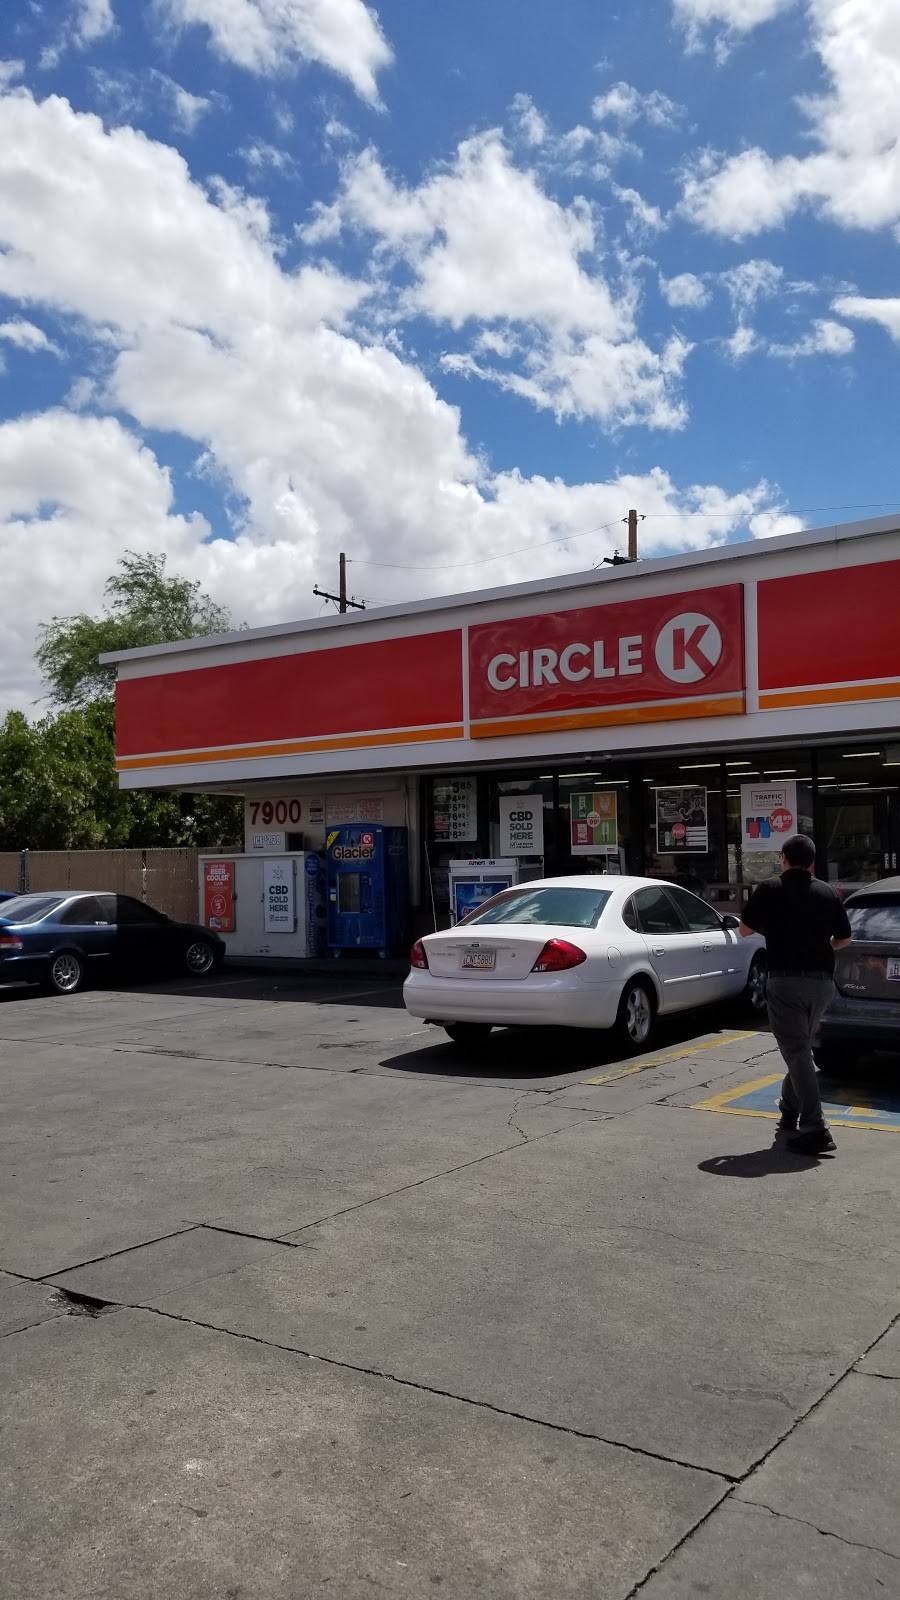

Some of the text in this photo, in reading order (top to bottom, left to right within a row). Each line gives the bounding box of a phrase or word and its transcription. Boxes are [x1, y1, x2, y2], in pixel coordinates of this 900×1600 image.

[487, 634, 643, 691] CIRCLE
[250, 799, 301, 825] 7900
[509, 811, 533, 822] CBD
[509, 823, 533, 831] SOLD
[510, 832, 533, 840] HERE
[333, 846, 374, 859] Glacier
[269, 885, 288, 894] CBD
[269, 904, 288, 912] HERE
